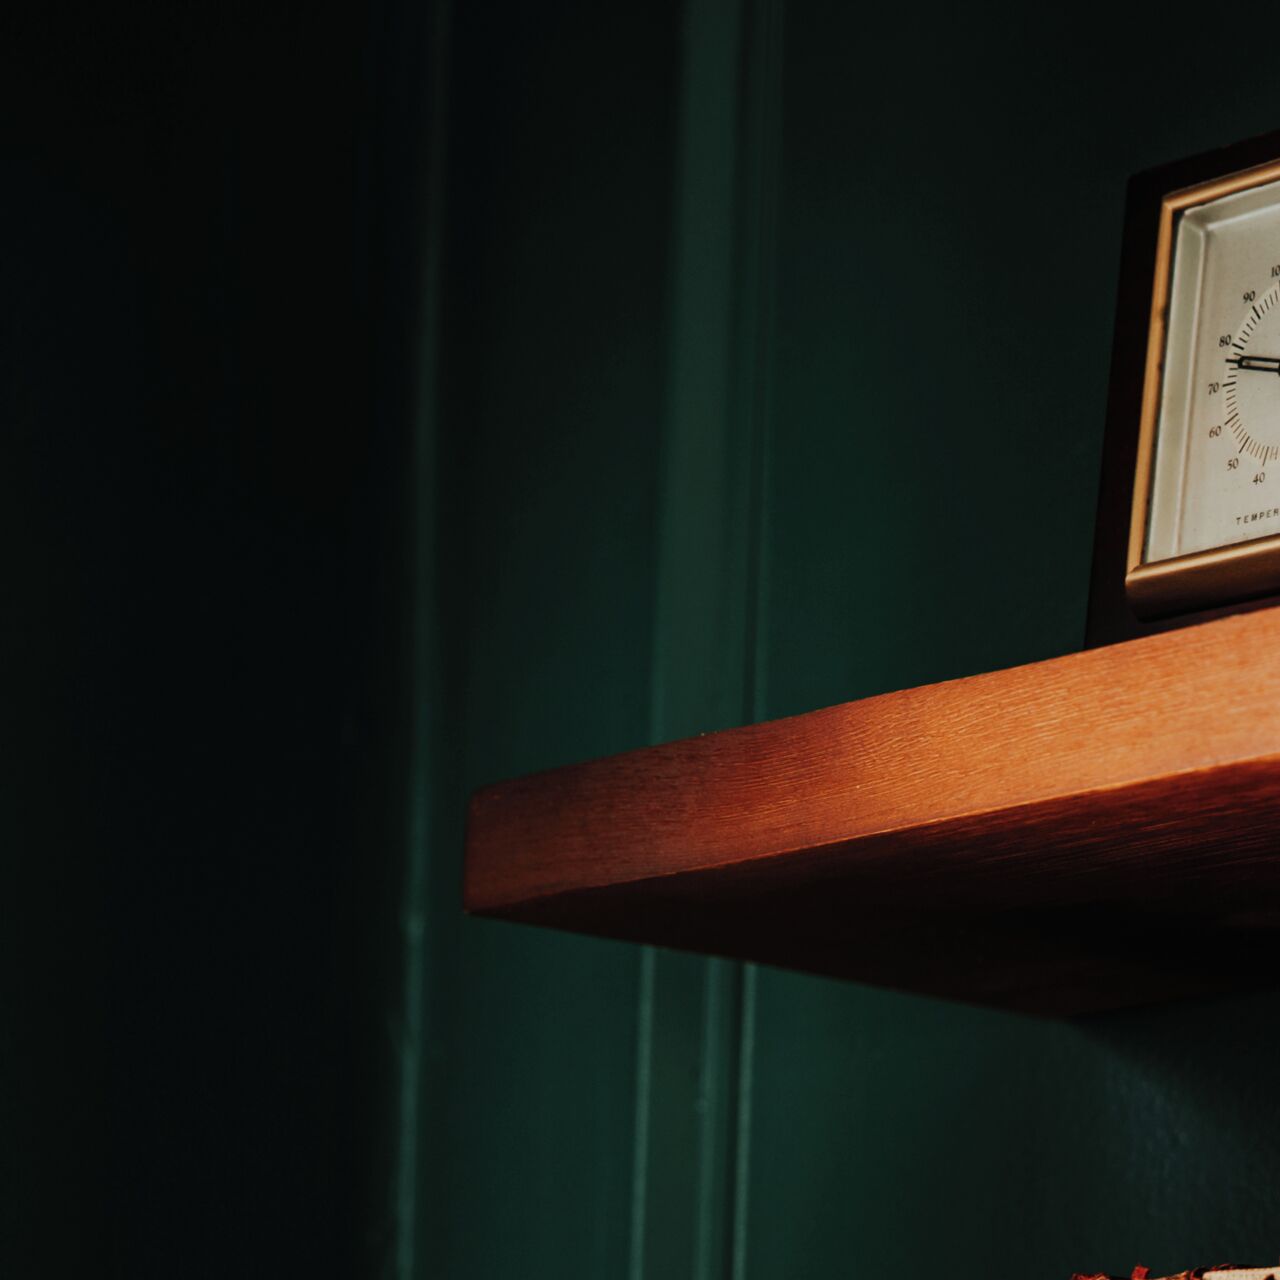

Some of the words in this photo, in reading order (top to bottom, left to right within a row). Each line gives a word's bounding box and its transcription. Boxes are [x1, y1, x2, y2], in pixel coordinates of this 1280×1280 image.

[1243, 290, 1256, 305] 90
[1218, 334, 1233, 348] 80
[1207, 382, 1220, 396] 70
[1208, 426, 1222, 439] 60
[1227, 458, 1240, 471] 50
[1252, 472, 1266, 485] 40
